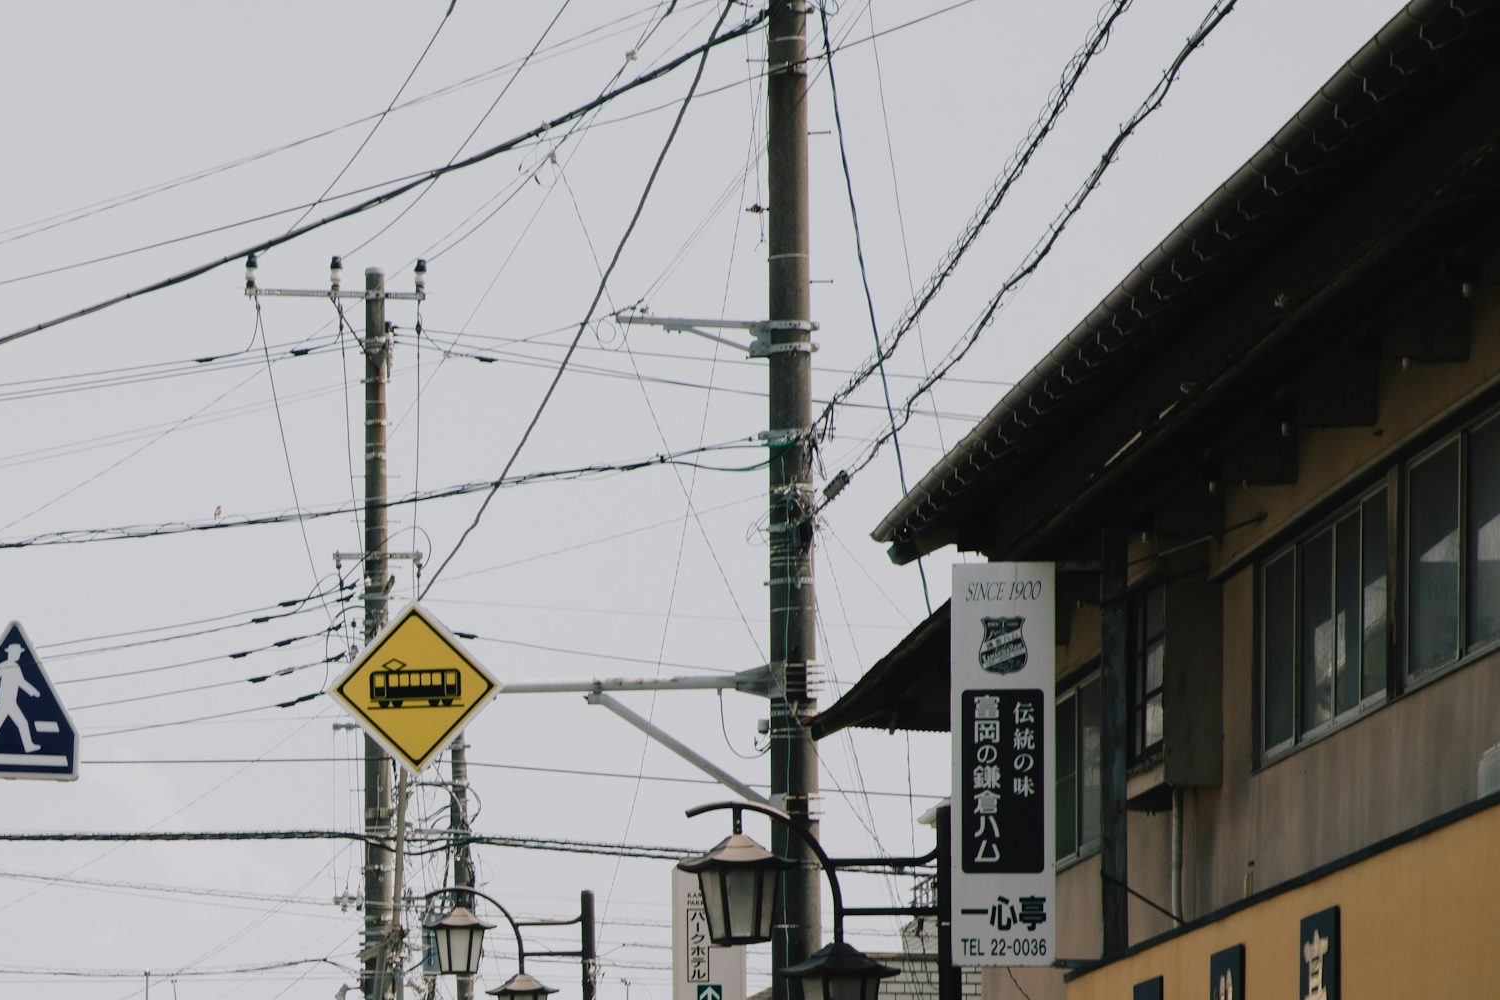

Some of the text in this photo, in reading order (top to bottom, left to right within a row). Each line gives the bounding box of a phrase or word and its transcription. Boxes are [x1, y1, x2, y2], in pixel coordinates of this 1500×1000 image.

[965, 581, 1042, 602] SINCE 1900
[1013, 701, 1036, 798] 伝統の味
[974, 695, 1001, 863] 富岡の鎌倉ハム
[961, 896, 1047, 931] 一心亭
[691, 912, 706, 980] パークホテル
[961, 938, 1047, 957] TEL 22-0036
